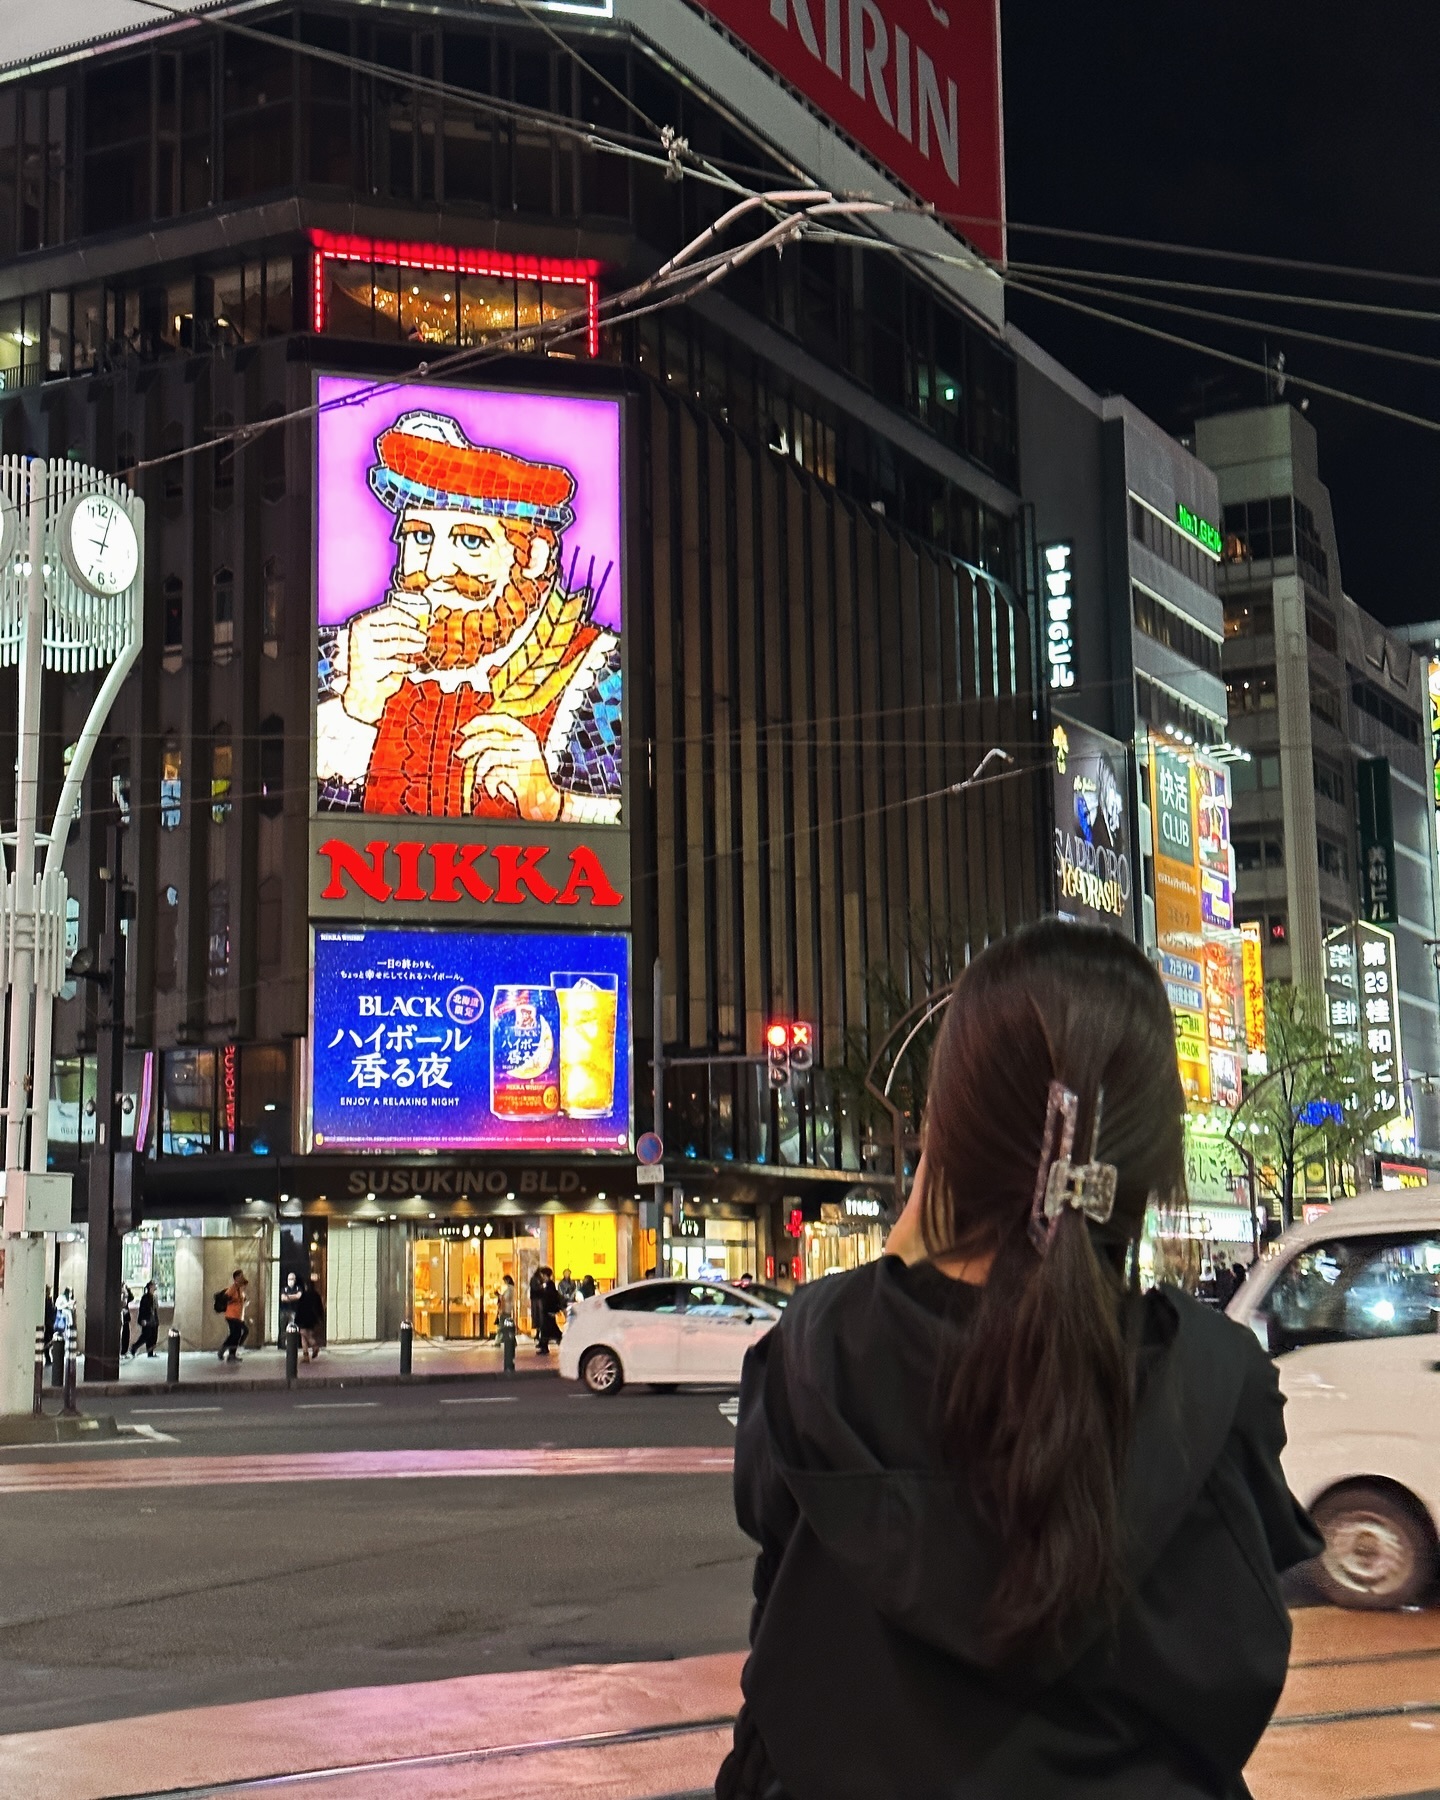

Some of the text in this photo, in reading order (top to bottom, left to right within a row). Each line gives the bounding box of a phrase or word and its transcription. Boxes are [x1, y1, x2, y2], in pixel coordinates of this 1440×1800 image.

[1159, 764, 1188, 815] 快活
[1162, 811, 1190, 848] CLUB
[317, 838, 625, 907] NIKKA
[1054, 827, 1131, 901] SAPPORO
[1169, 957, 1195, 981] カラオケ
[358, 995, 444, 1018] BLACK
[327, 1022, 473, 1053] ハイボール
[1362, 941, 1396, 1113] 第23桂和ビル
[348, 1052, 454, 1090] 香る夜
[340, 1096, 460, 1107] ENJOY A RELAXING NIGHT
[347, 1169, 588, 1194] SUSUKINO BLD.
